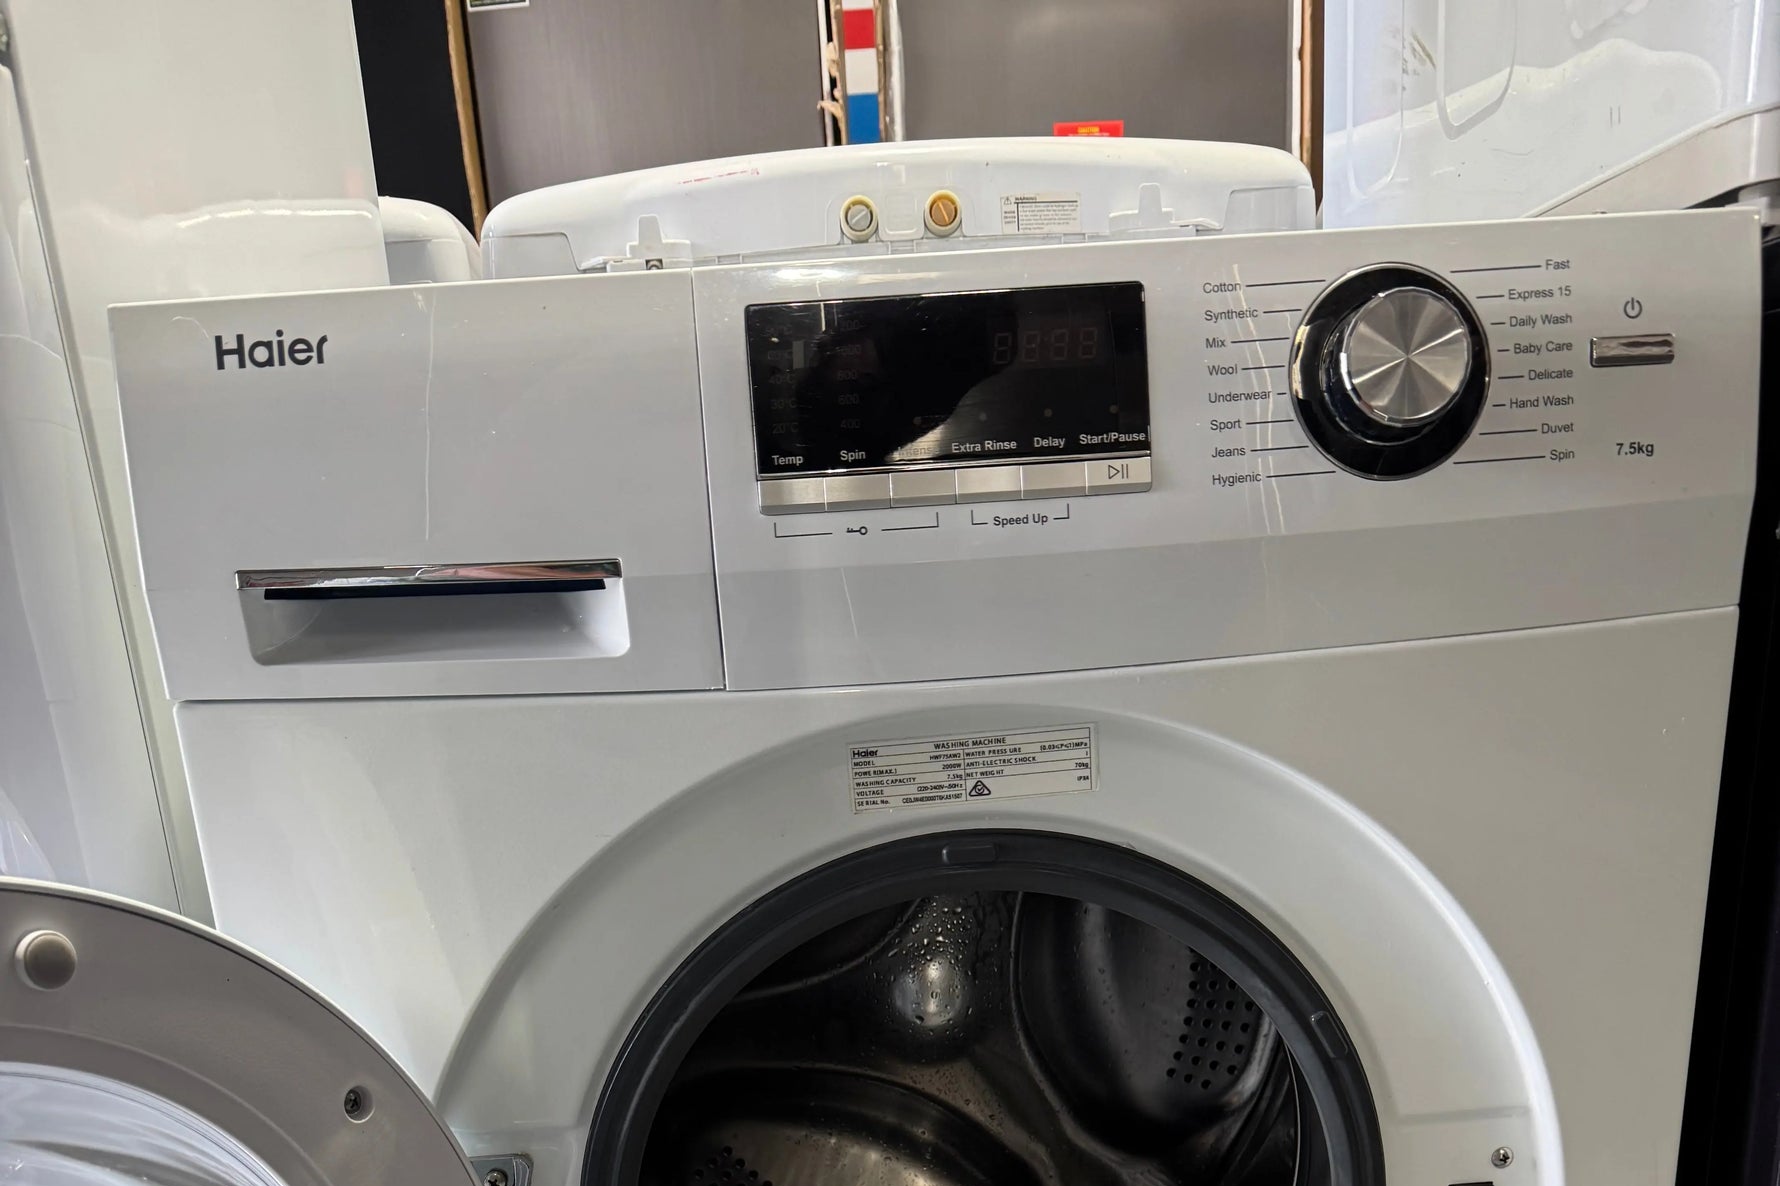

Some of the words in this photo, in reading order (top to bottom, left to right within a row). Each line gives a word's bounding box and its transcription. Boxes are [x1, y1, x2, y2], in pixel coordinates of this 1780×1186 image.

[1545, 259, 1571, 270] Fast
[1203, 282, 1242, 294] Cotton
[1508, 288, 1554, 302] Express
[1558, 286, 1572, 297] 15
[1204, 309, 1259, 324] Synthetic
[1509, 315, 1537, 328] Daily
[1540, 313, 1573, 325] Wash
[215, 329, 328, 370] Haier
[1205, 337, 1226, 349] Mix
[1513, 343, 1542, 355] Baby
[1545, 341, 1573, 352] Care
[1207, 364, 1238, 376] Wool
[1528, 368, 1574, 381] Delicate
[1208, 389, 1272, 404] Underwear
[1509, 397, 1540, 409] Hand
[1542, 395, 1574, 407] Wash
[1210, 419, 1242, 432] Sport
[1541, 422, 1574, 435] Duvet
[1033, 435, 1065, 449] Delay
[1079, 430, 1146, 445] Start/Pause
[951, 440, 981, 453] Extra
[984, 438, 1017, 451] Rinse
[1211, 446, 1246, 458] Jeans
[1616, 441, 1655, 457] 7.5kg
[772, 453, 804, 468] Temp
[840, 449, 866, 463] Spin
[1550, 449, 1575, 462] Spin
[1212, 472, 1262, 488] Hygienic
[993, 513, 1028, 527] Speed
[1031, 513, 1049, 526] Up
[934, 741, 970, 750] WASHING
[971, 737, 1007, 747] MACHINE
[852, 749, 879, 758] Haier
[965, 750, 986, 758] WATER
[855, 779, 885, 788] WASHING
